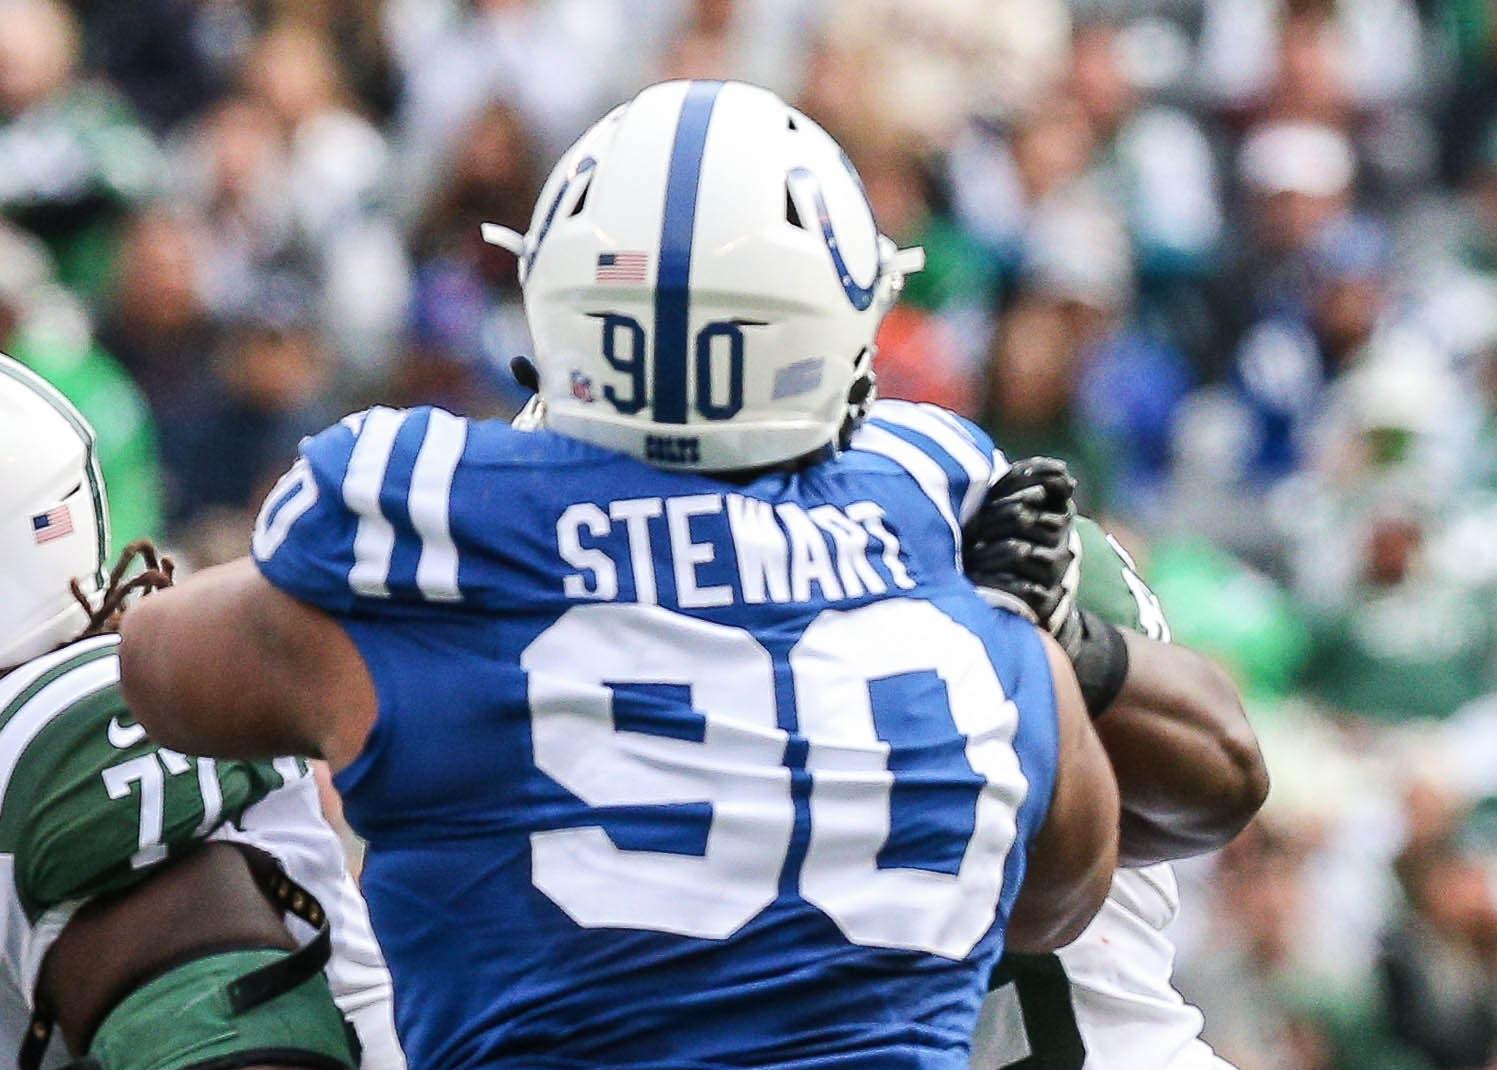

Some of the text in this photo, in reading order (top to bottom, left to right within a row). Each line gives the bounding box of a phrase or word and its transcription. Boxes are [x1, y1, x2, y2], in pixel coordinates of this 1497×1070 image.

[602, 314, 745, 421] 90
[555, 492, 917, 609] STEWART
[519, 598, 1030, 962] 90
